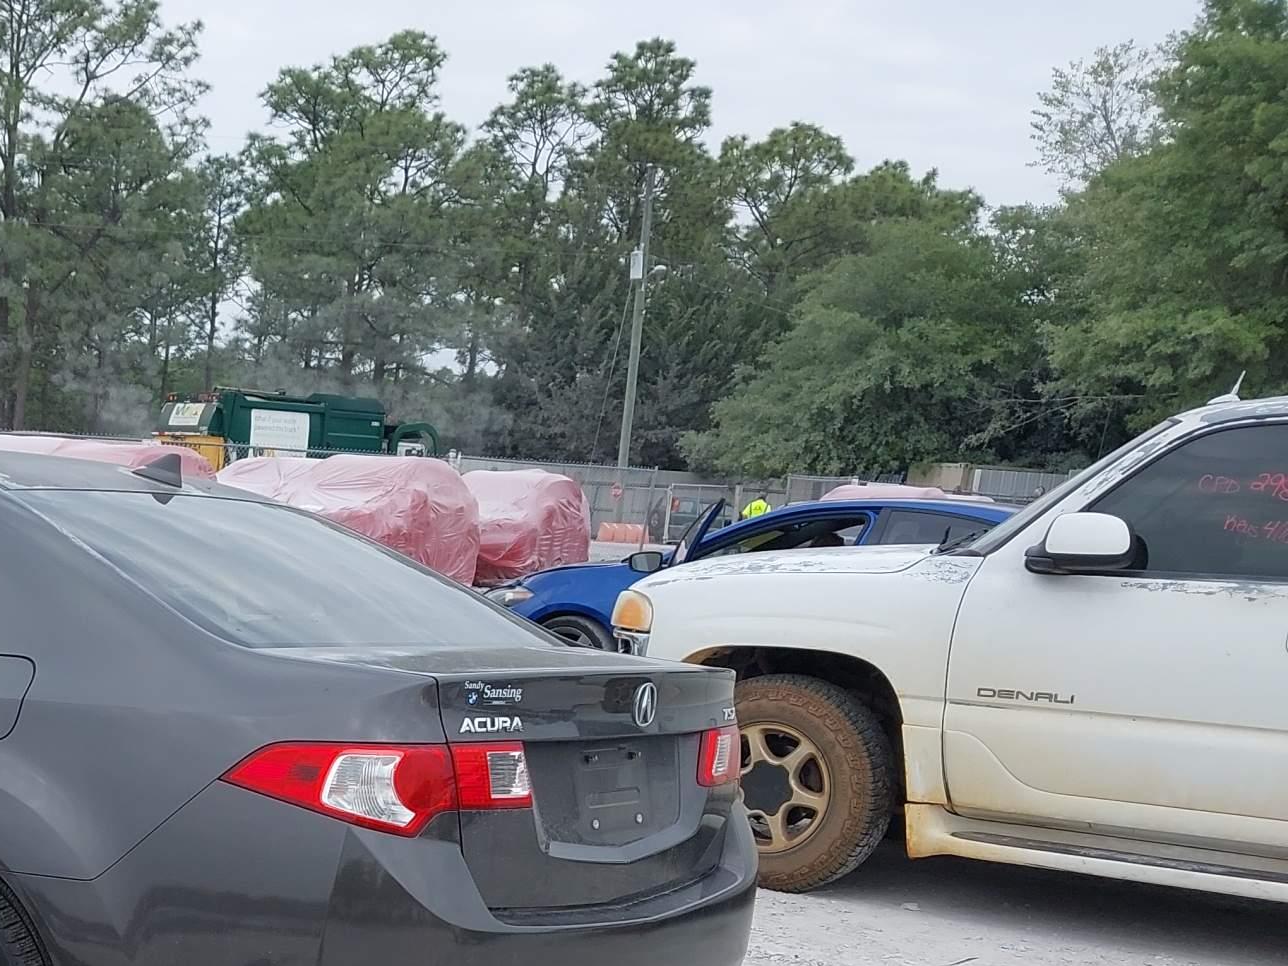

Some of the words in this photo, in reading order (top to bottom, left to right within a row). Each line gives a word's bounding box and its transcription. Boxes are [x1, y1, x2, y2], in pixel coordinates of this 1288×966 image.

[464, 680, 485, 691] Sandy
[483, 684, 523, 702] Sansing
[976, 687, 1075, 704] DENALI
[459, 716, 525, 733] ACURA
